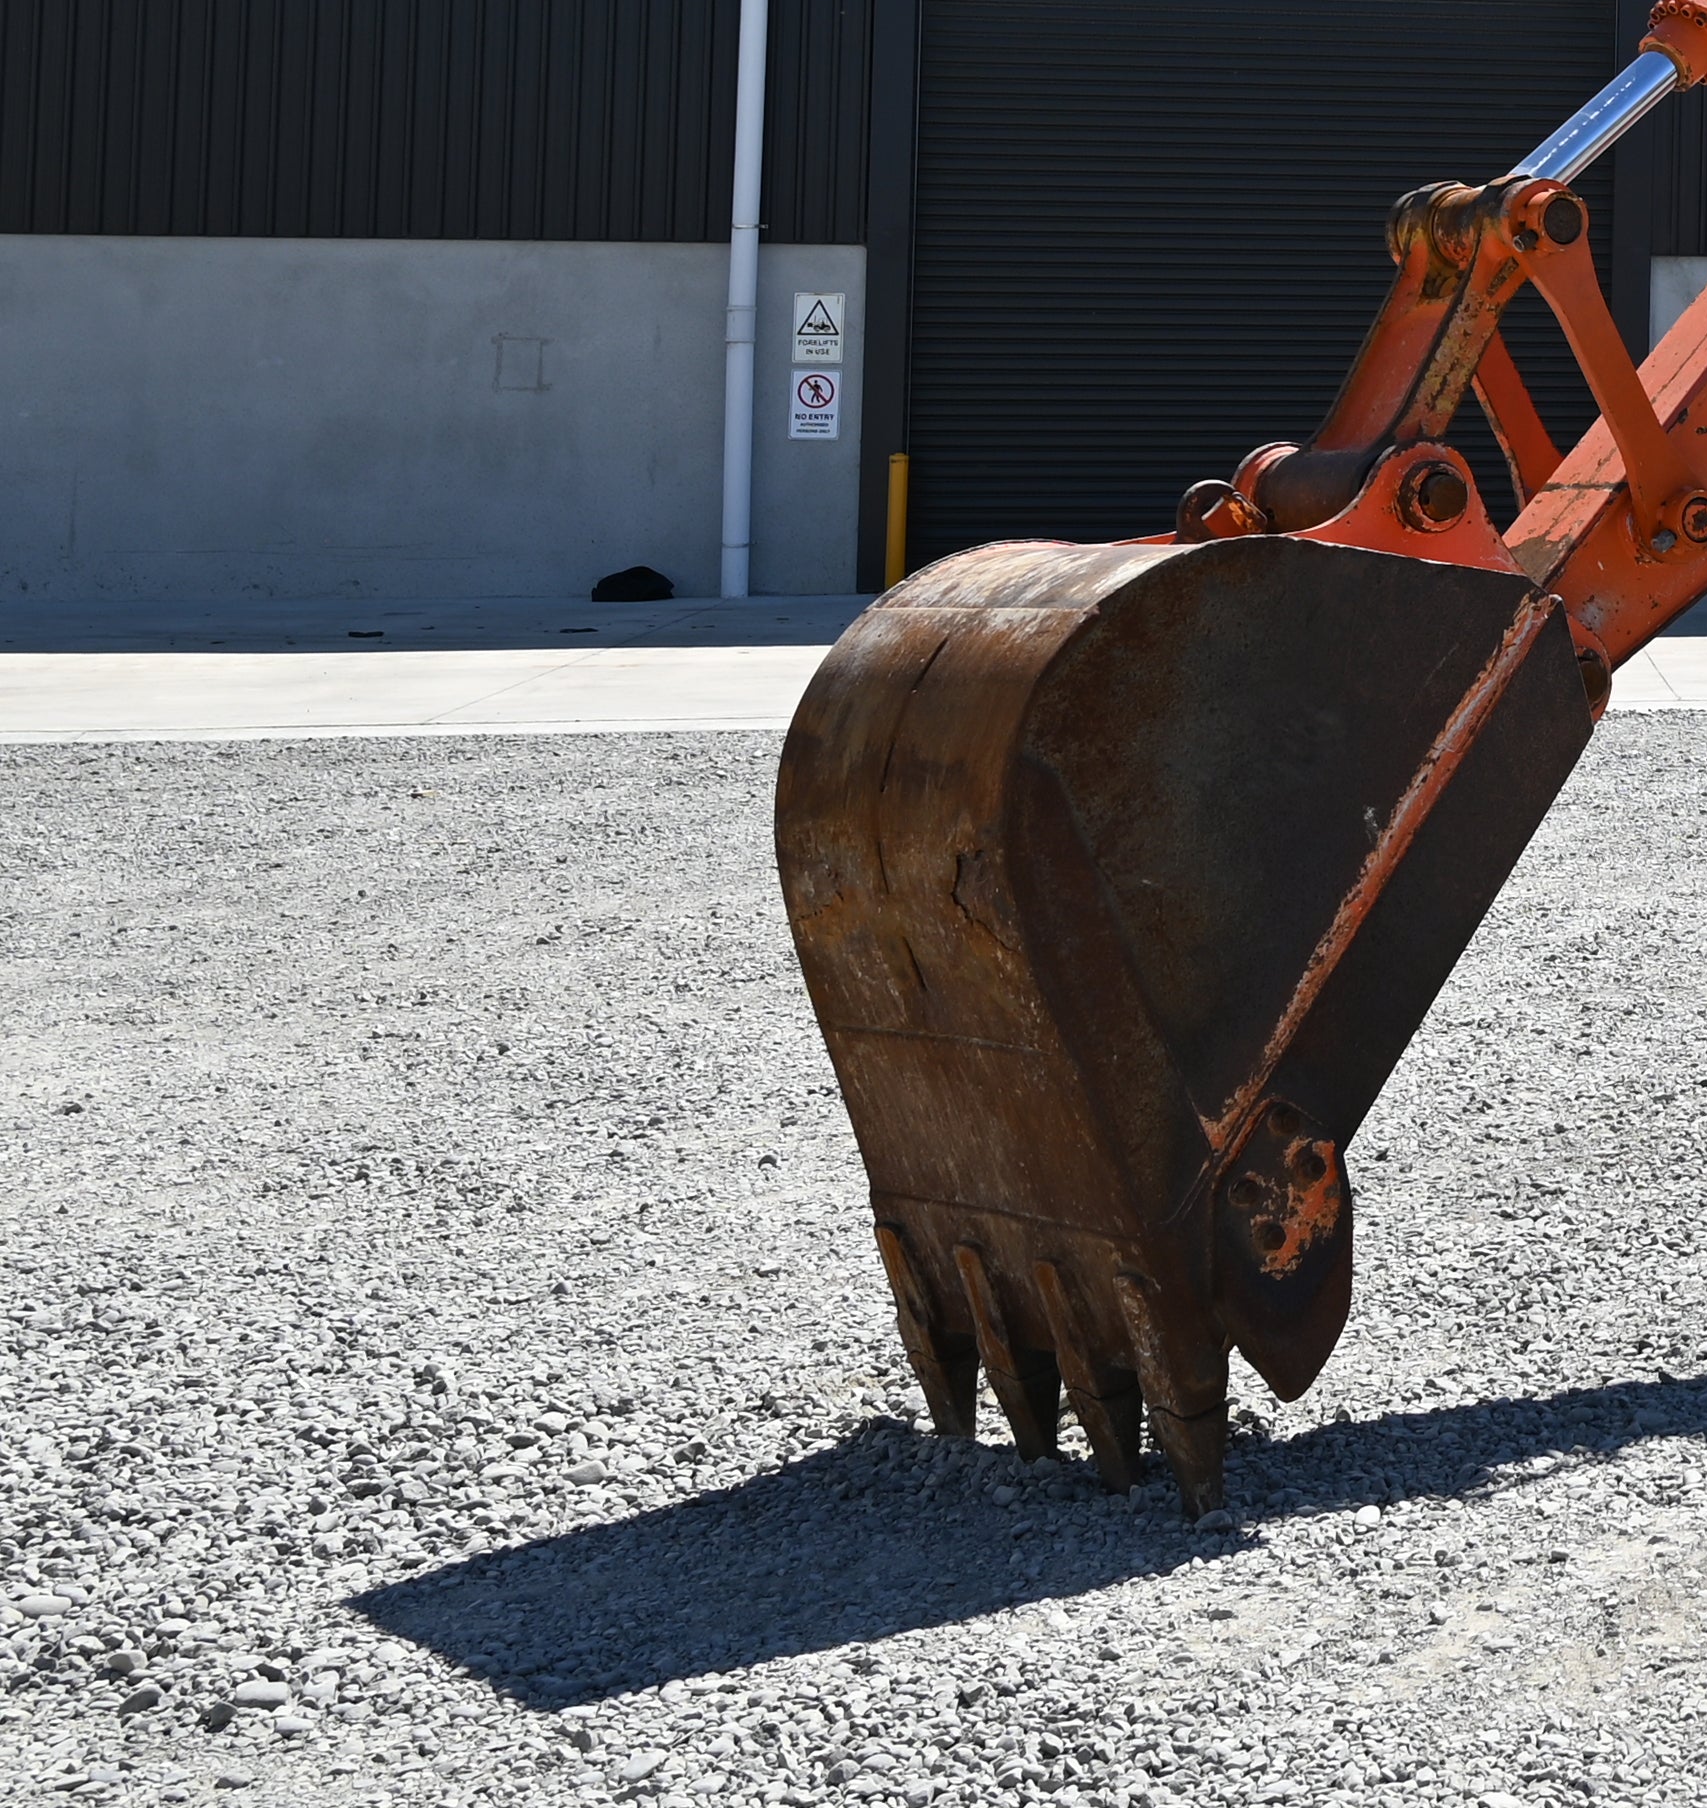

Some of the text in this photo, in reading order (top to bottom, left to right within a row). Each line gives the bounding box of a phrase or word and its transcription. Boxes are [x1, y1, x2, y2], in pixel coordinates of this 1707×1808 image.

[798, 339, 839, 347] FORKLIFTS
[795, 413, 835, 421] NO ENTRY
